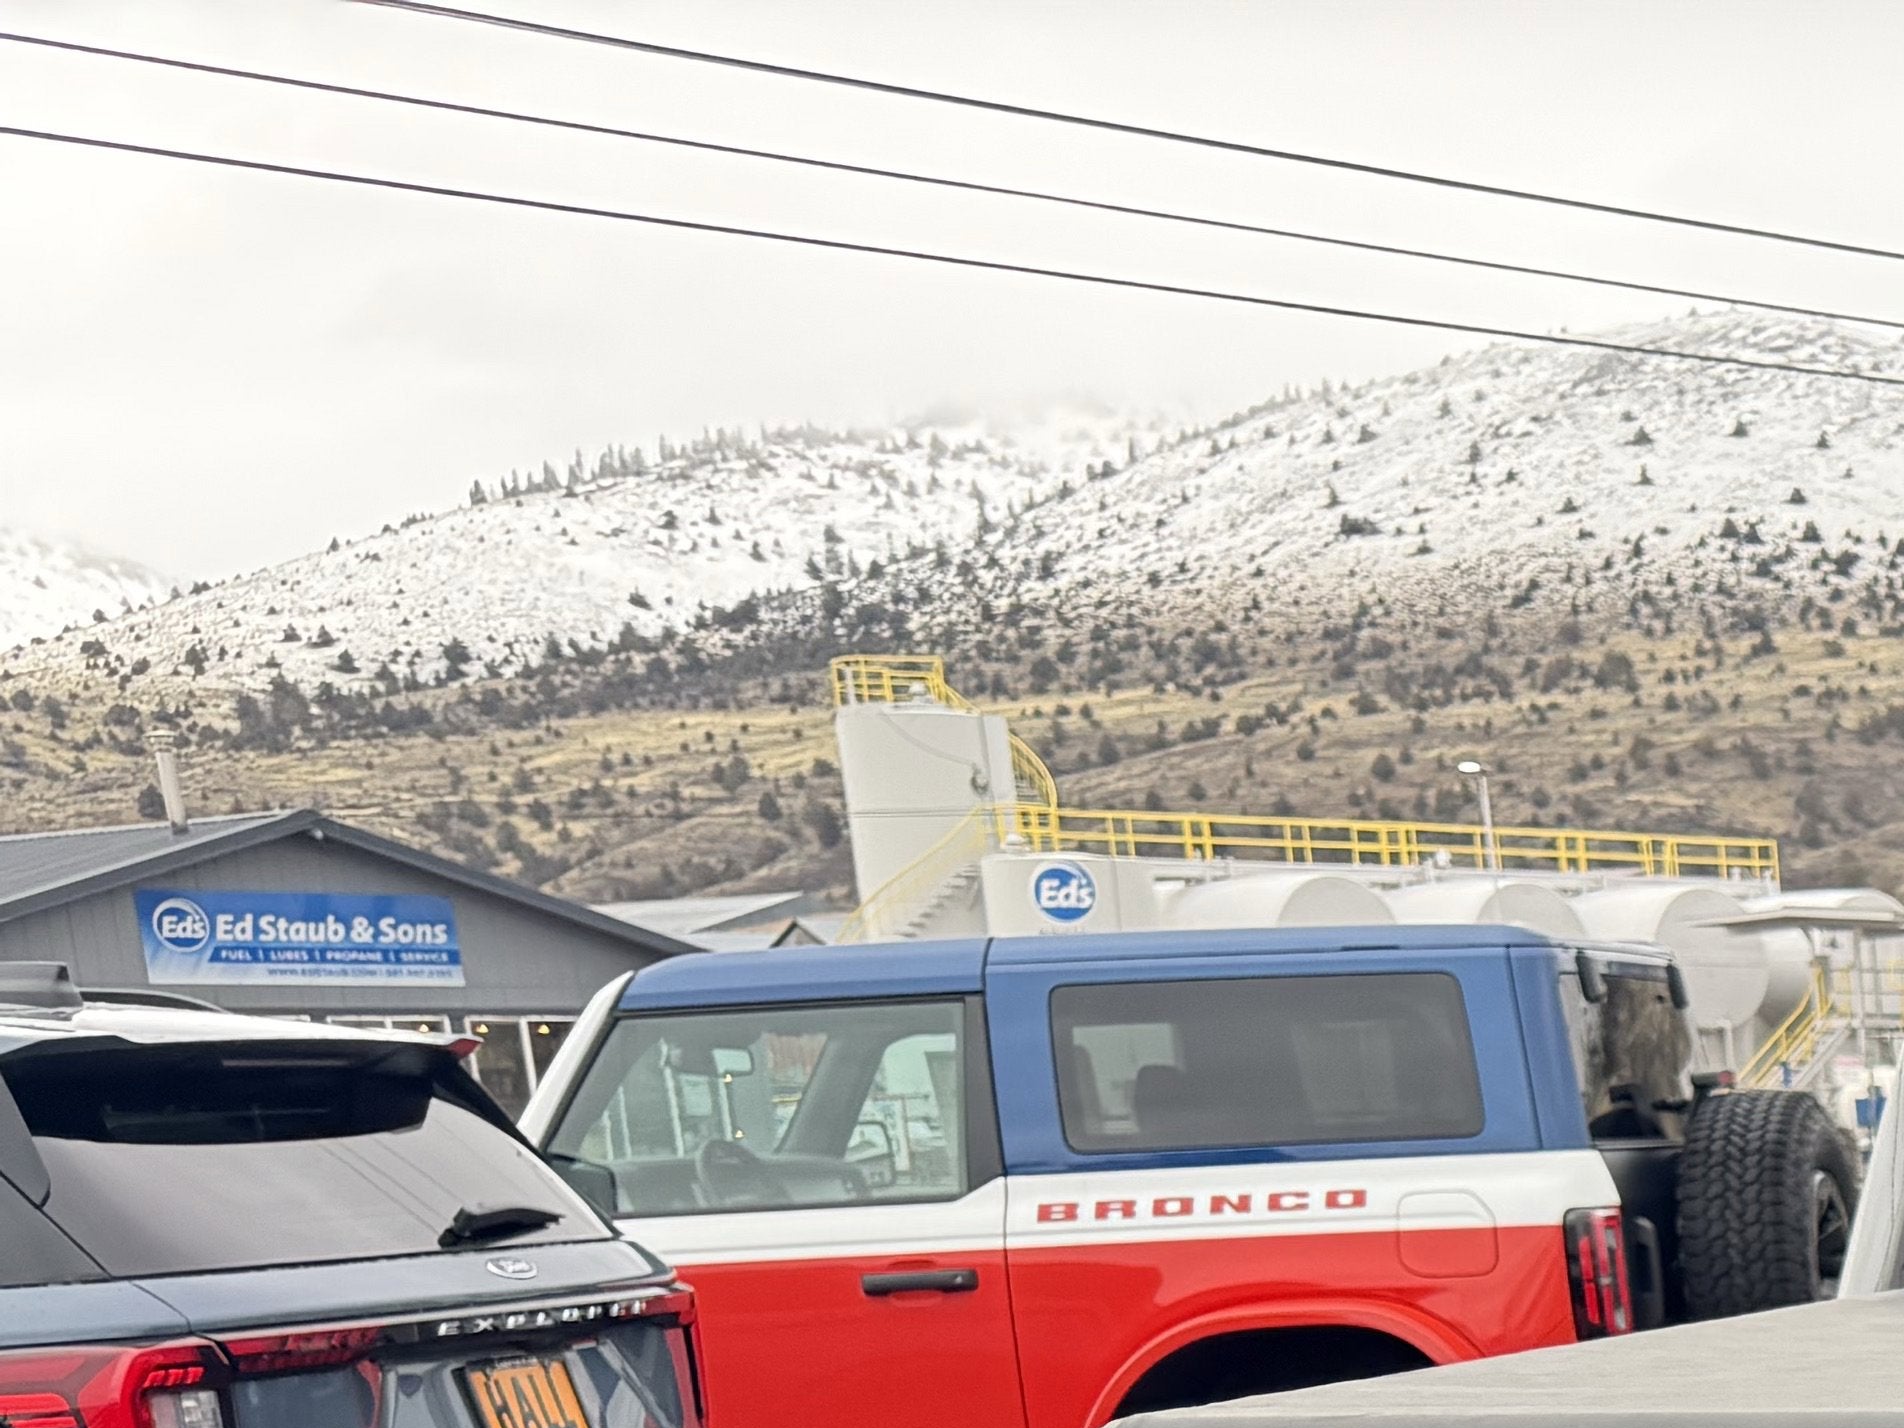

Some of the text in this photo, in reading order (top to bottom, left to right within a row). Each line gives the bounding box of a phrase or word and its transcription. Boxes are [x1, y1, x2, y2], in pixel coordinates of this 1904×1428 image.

[216, 914, 448, 945] Ed Staub & Sons
[221, 949, 251, 960] FUEL
[1037, 1189, 1367, 1223] BRONCO
